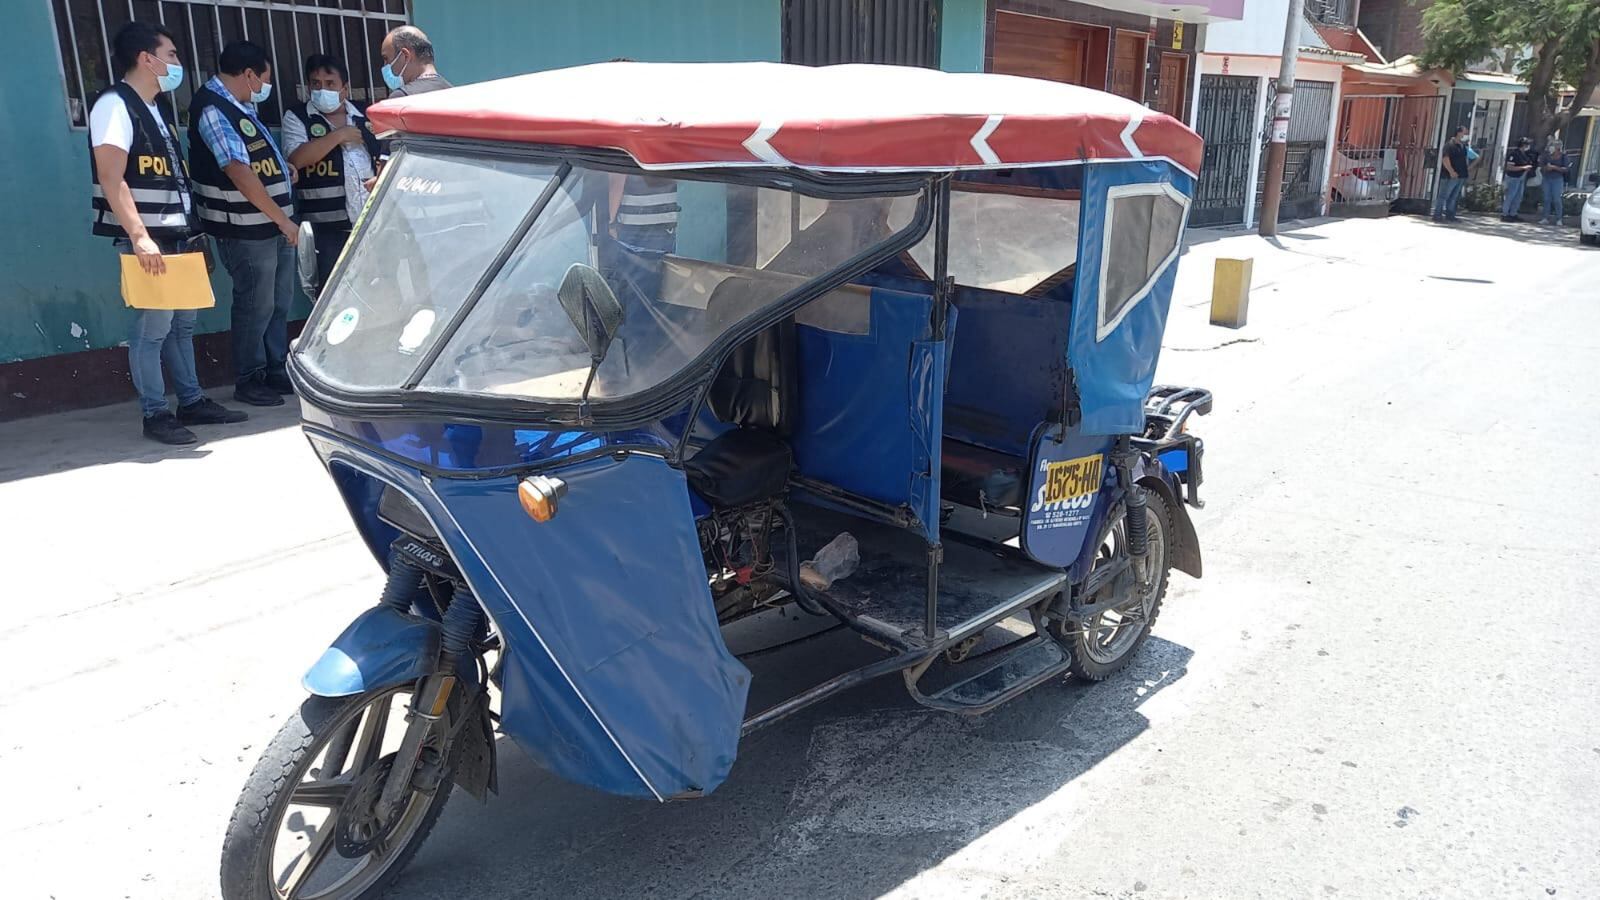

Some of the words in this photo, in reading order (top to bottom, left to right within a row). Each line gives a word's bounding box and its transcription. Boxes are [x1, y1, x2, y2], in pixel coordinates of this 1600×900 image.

[139, 155, 171, 177] POL
[251, 157, 281, 177] POL
[306, 160, 339, 178] POL
[403, 543, 436, 562] STILOS
